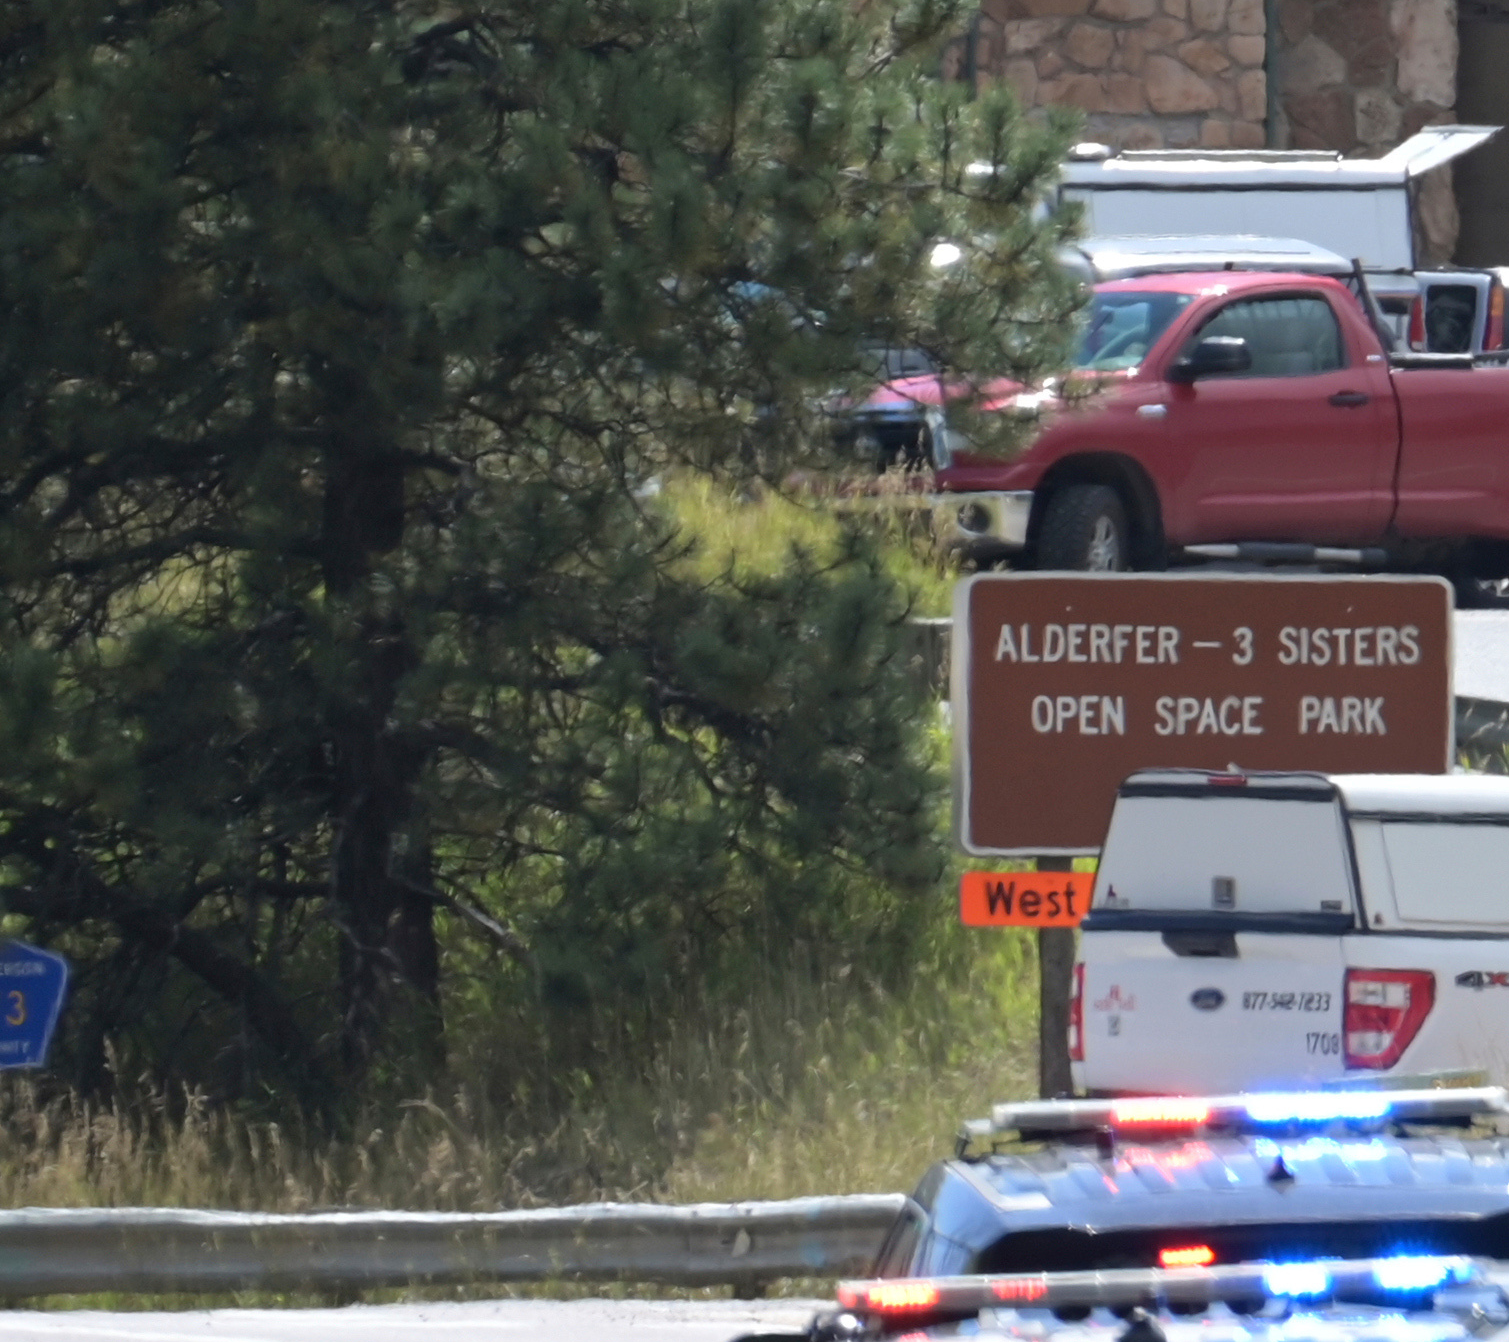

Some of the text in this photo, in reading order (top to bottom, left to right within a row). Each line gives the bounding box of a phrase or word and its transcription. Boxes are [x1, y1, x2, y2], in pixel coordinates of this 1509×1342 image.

[994, 622, 1180, 665] ALDERFER
[1232, 626, 1254, 665] 3
[1278, 625, 1421, 665] SISTERS
[1032, 695, 1388, 736] OPEN SPACE PARK
[985, 880, 1076, 918] West
[1305, 1032, 1340, 1056] 1708
